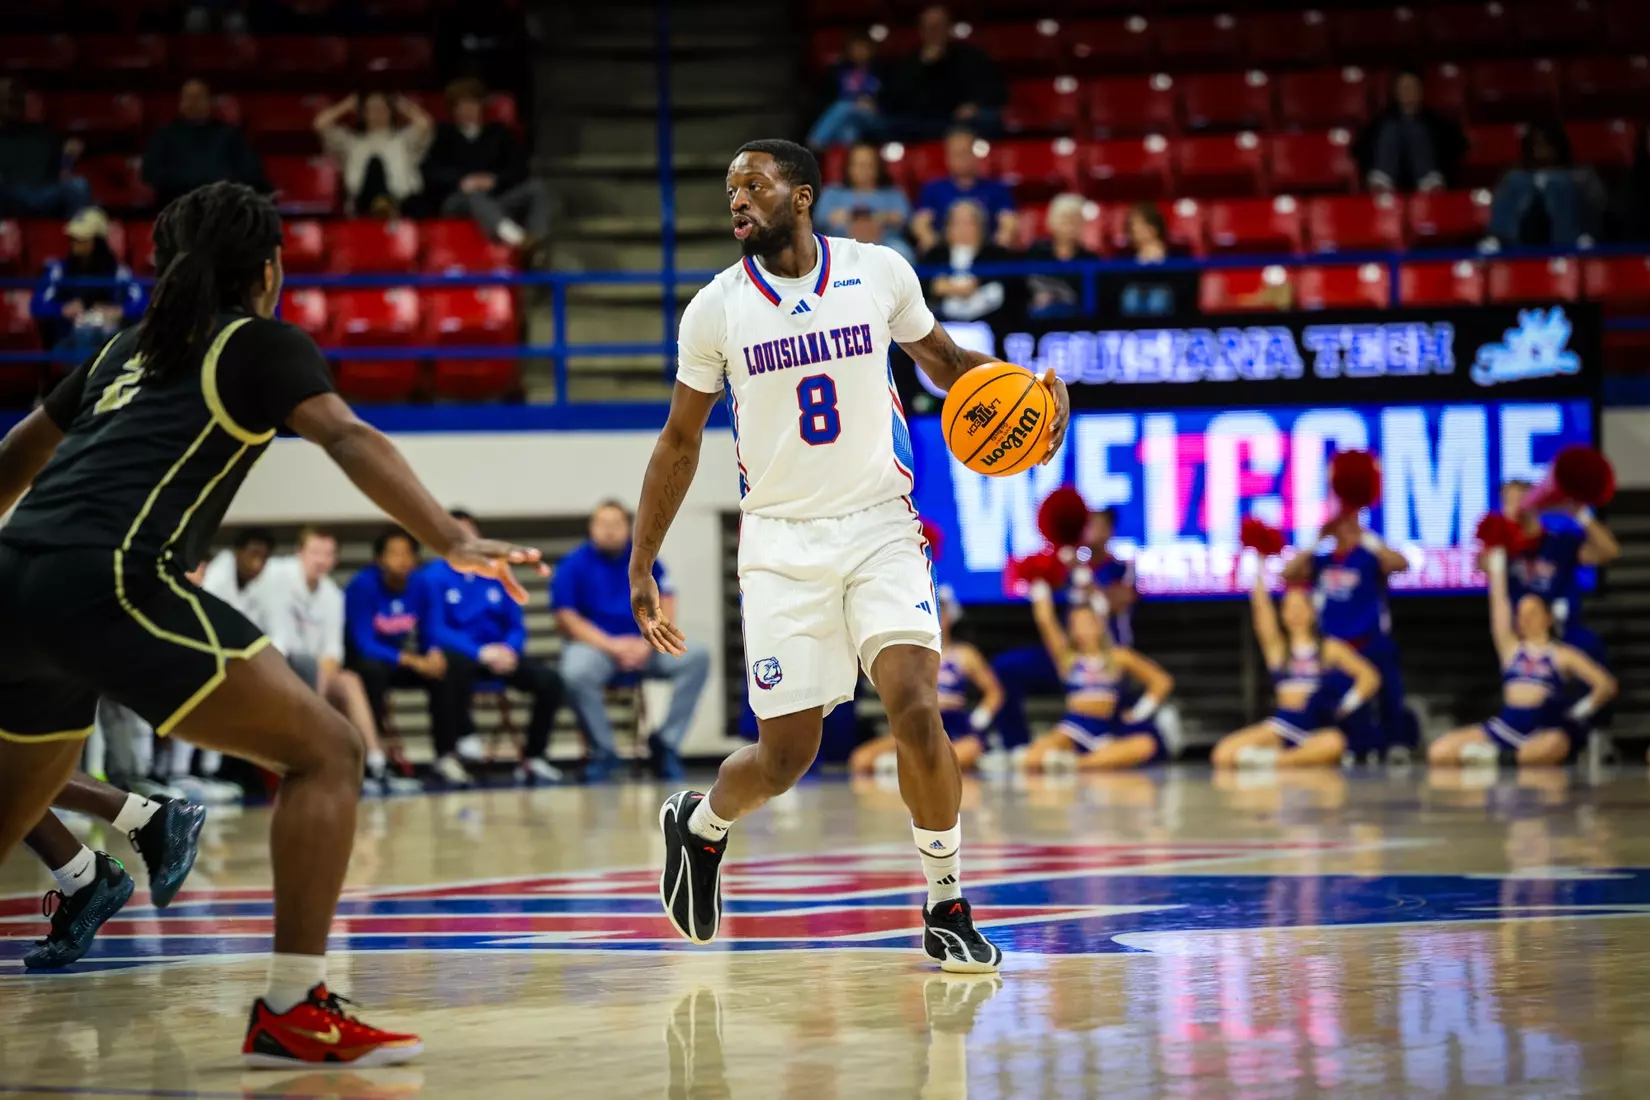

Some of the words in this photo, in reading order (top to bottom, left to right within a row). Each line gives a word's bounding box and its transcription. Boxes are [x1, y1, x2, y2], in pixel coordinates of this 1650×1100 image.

[743, 331, 831, 376] LOUISIANA
[830, 324, 873, 359] TECH
[1303, 321, 1455, 377] TECH
[796, 373, 841, 446] 8
[980, 408, 1041, 466] Wilson
